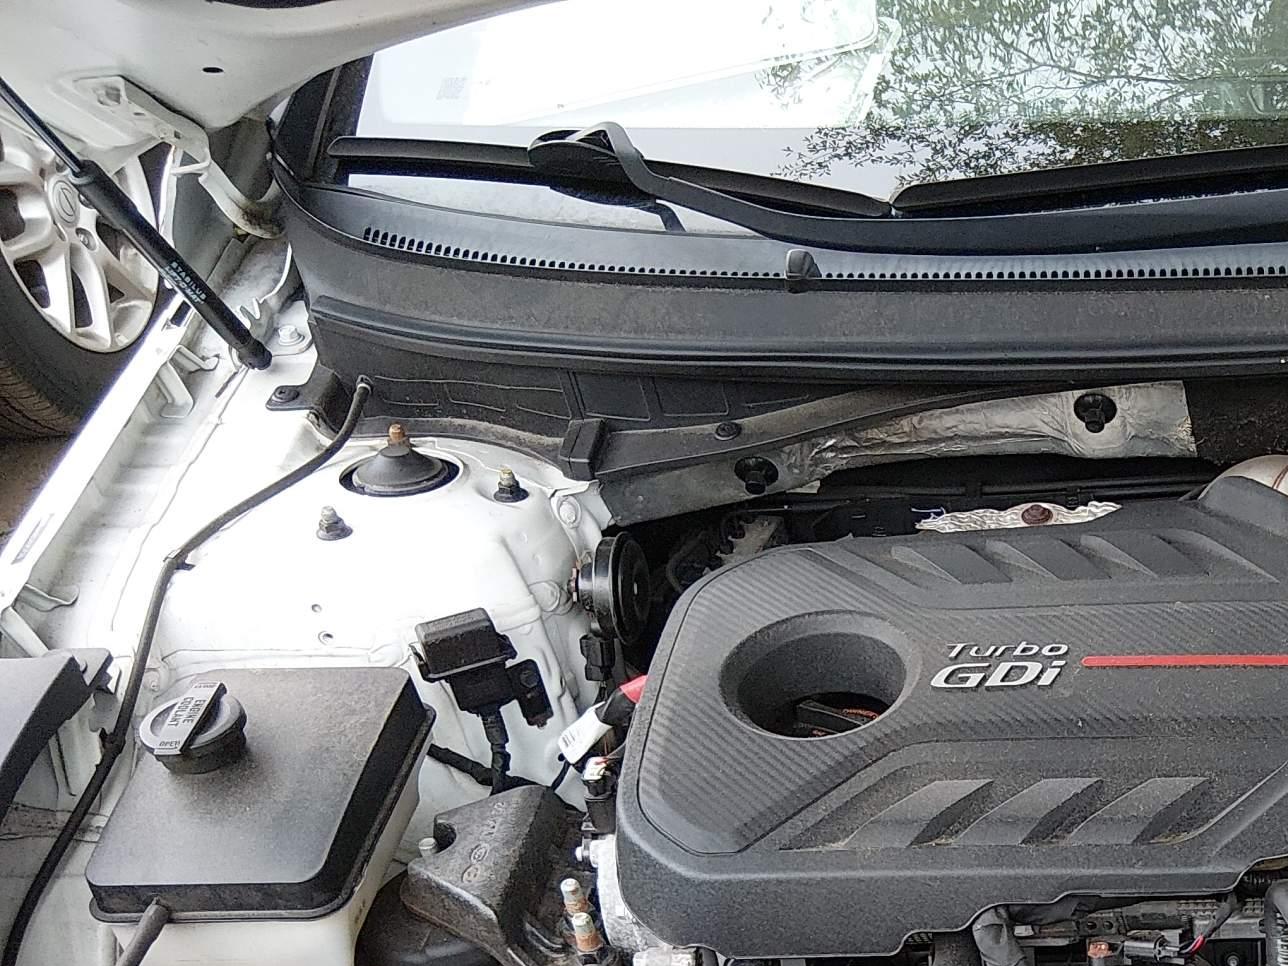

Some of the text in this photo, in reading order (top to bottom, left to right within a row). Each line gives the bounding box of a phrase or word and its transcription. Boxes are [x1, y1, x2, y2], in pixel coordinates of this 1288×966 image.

[170, 261, 207, 300] STABILUS
[946, 641, 1069, 658] Turbo
[930, 660, 1067, 688] GDi
[168, 696, 195, 727] COOLANT
[182, 699, 207, 724] ENGINE
